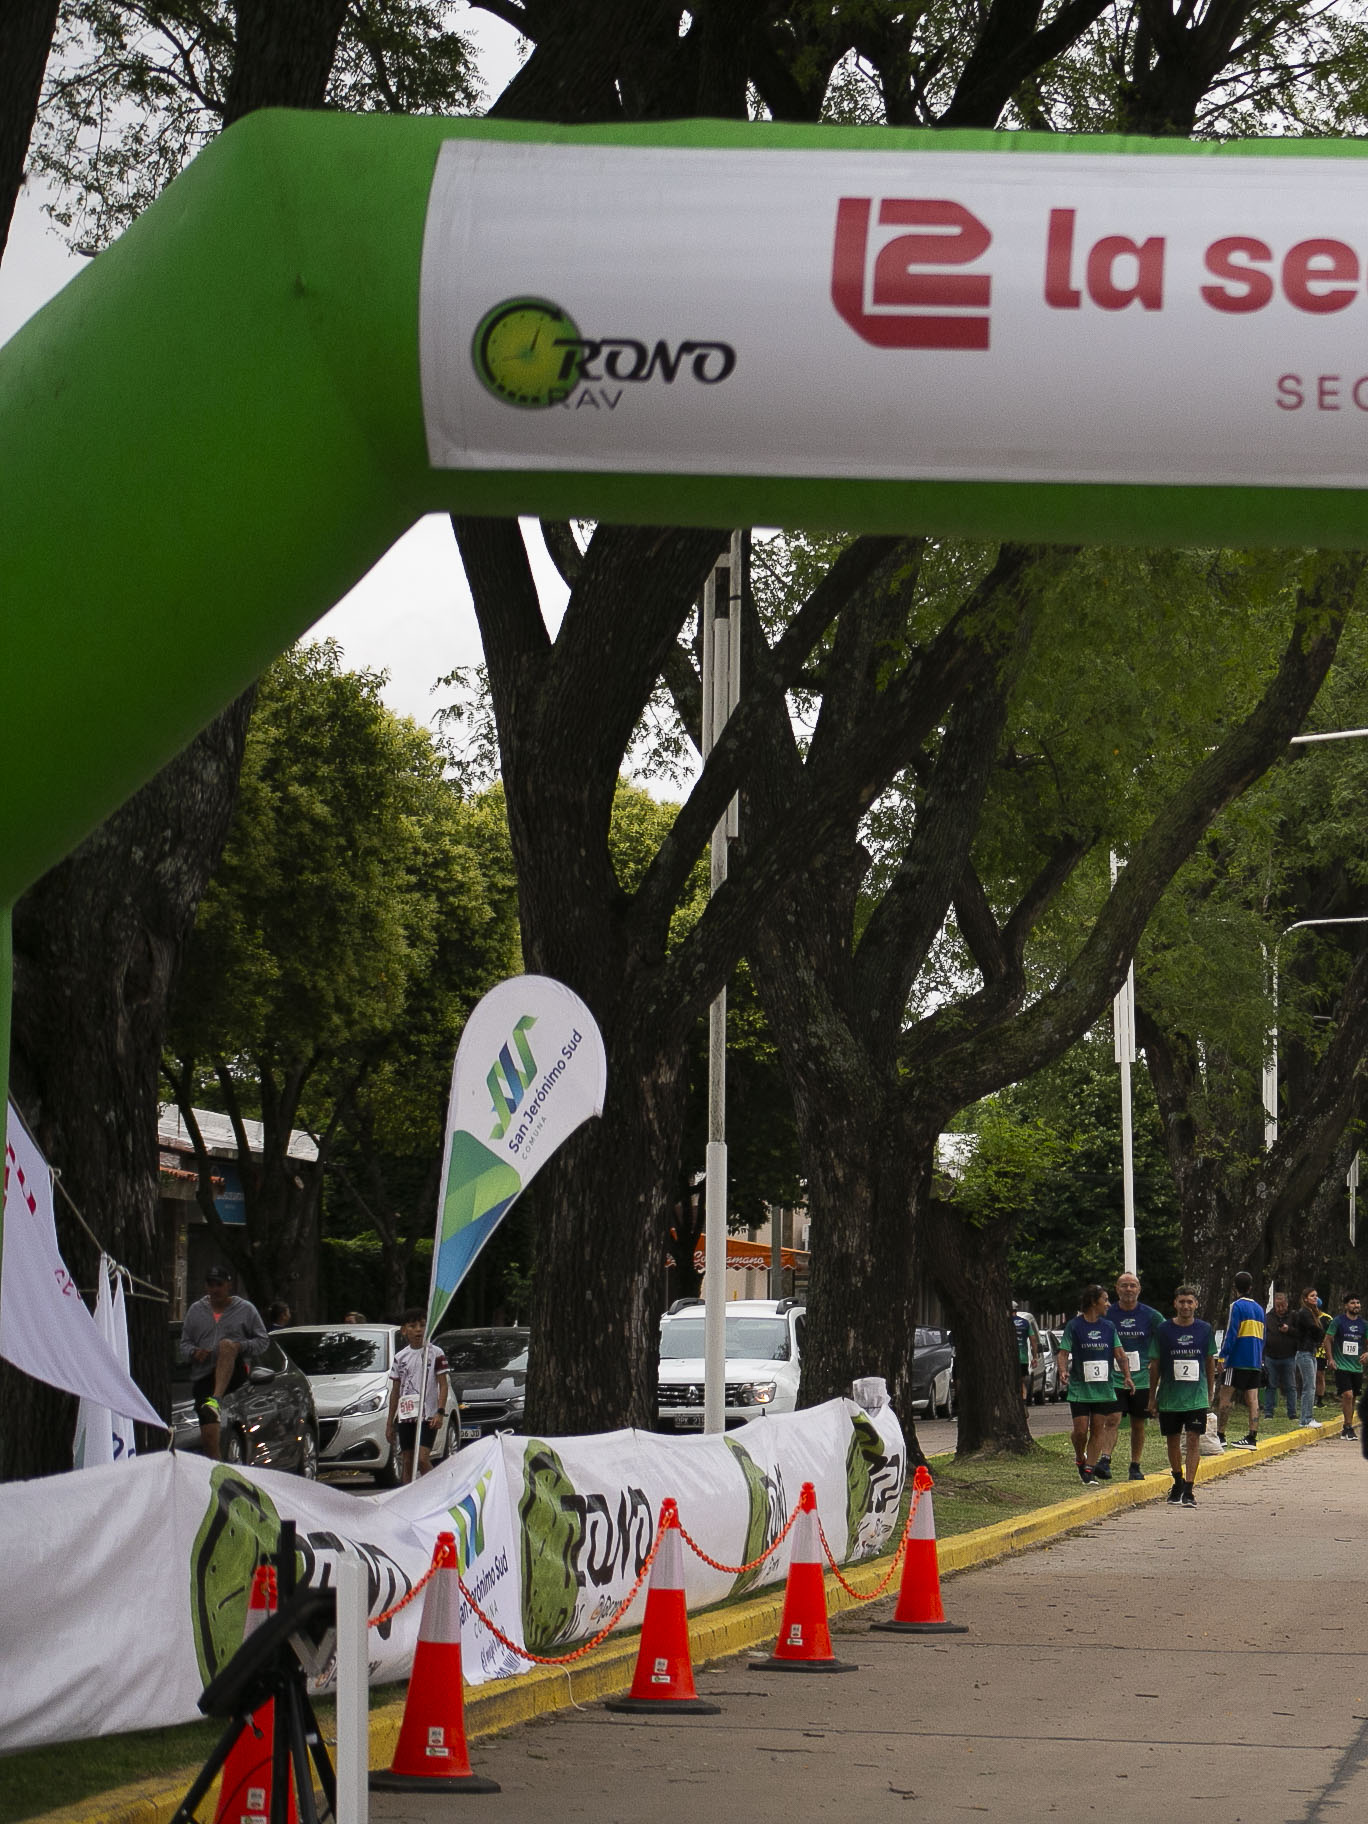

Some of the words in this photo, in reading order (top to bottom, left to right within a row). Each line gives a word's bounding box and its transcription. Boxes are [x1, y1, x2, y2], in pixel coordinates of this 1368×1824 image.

[1044, 208, 1166, 312] la
[508, 1127, 529, 1154] San
[523, 1059, 567, 1124] Jerónimo
[561, 1028, 583, 1060] Sud
[522, 1116, 547, 1160] COMUNA
[1094, 1366, 1100, 1376] 3
[1182, 1365, 1189, 1376] 2
[460, 1600, 469, 1628] an
[495, 1546, 509, 1581] Sud
